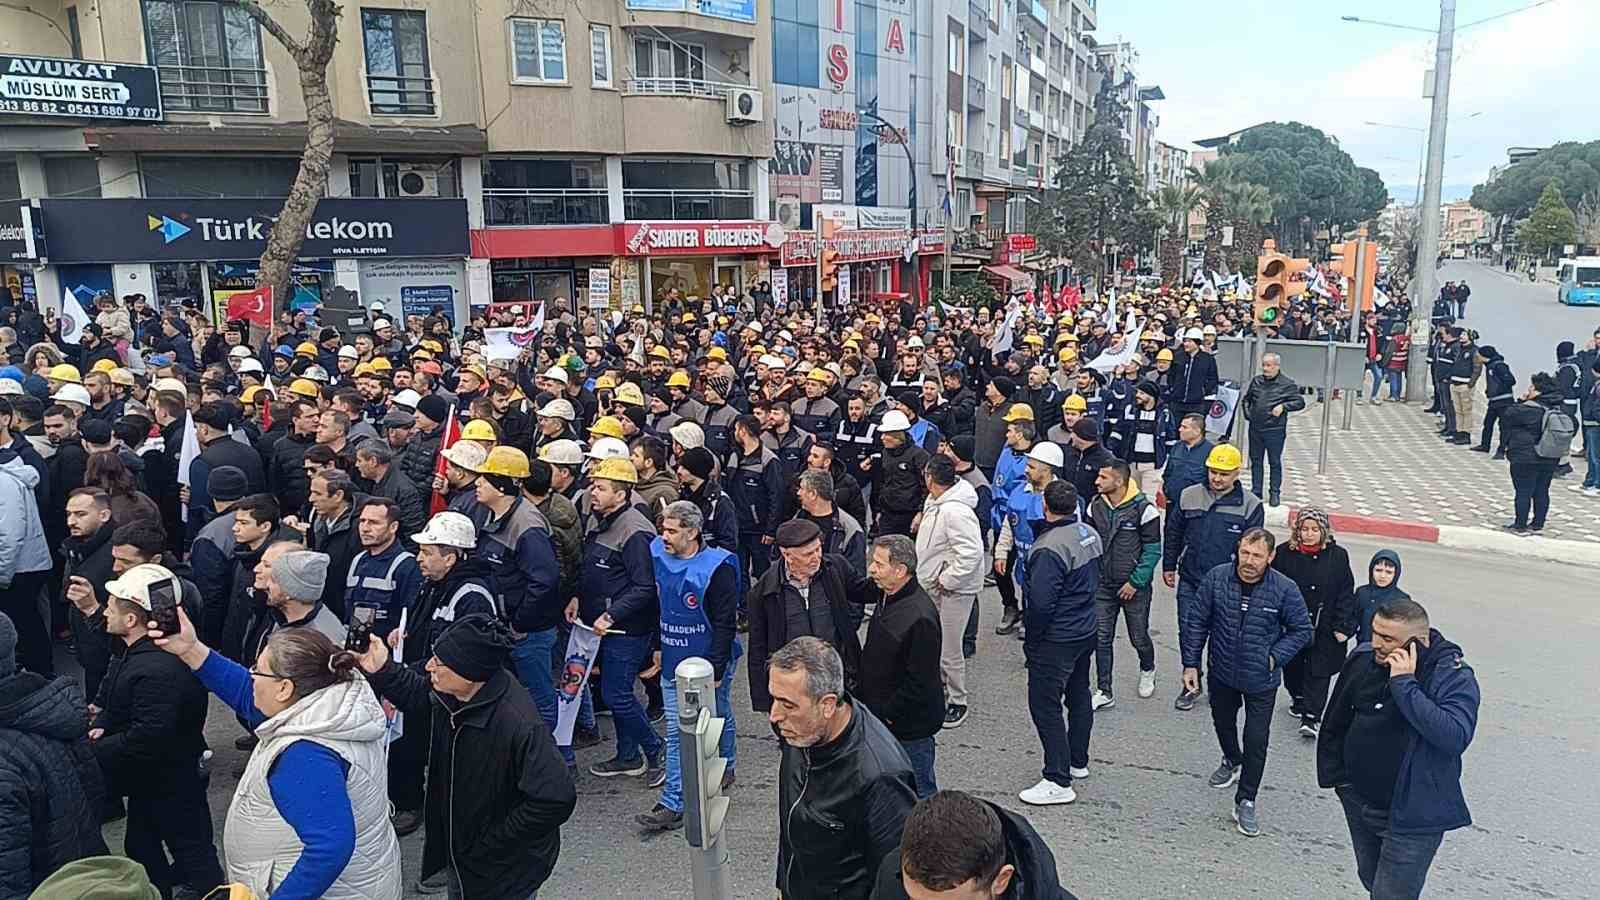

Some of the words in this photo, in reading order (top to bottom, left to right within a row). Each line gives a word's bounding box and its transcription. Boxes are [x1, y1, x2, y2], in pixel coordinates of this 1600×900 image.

[8, 59, 117, 79] AVUKAT
[7, 79, 77, 99] MÜSLÜM
[82, 86, 121, 101] SERT
[23, 101, 38, 111] 86
[42, 102, 58, 113] 82
[67, 104, 99, 115] 0543
[101, 106, 123, 116] 680
[127, 108, 140, 117] 97
[144, 108, 157, 118] 07
[196, 217, 265, 241] Türk
[271, 216, 393, 240] lekom
[649, 229, 699, 248] SARIYER
[704, 224, 764, 251] BÖREKÇİSİ
